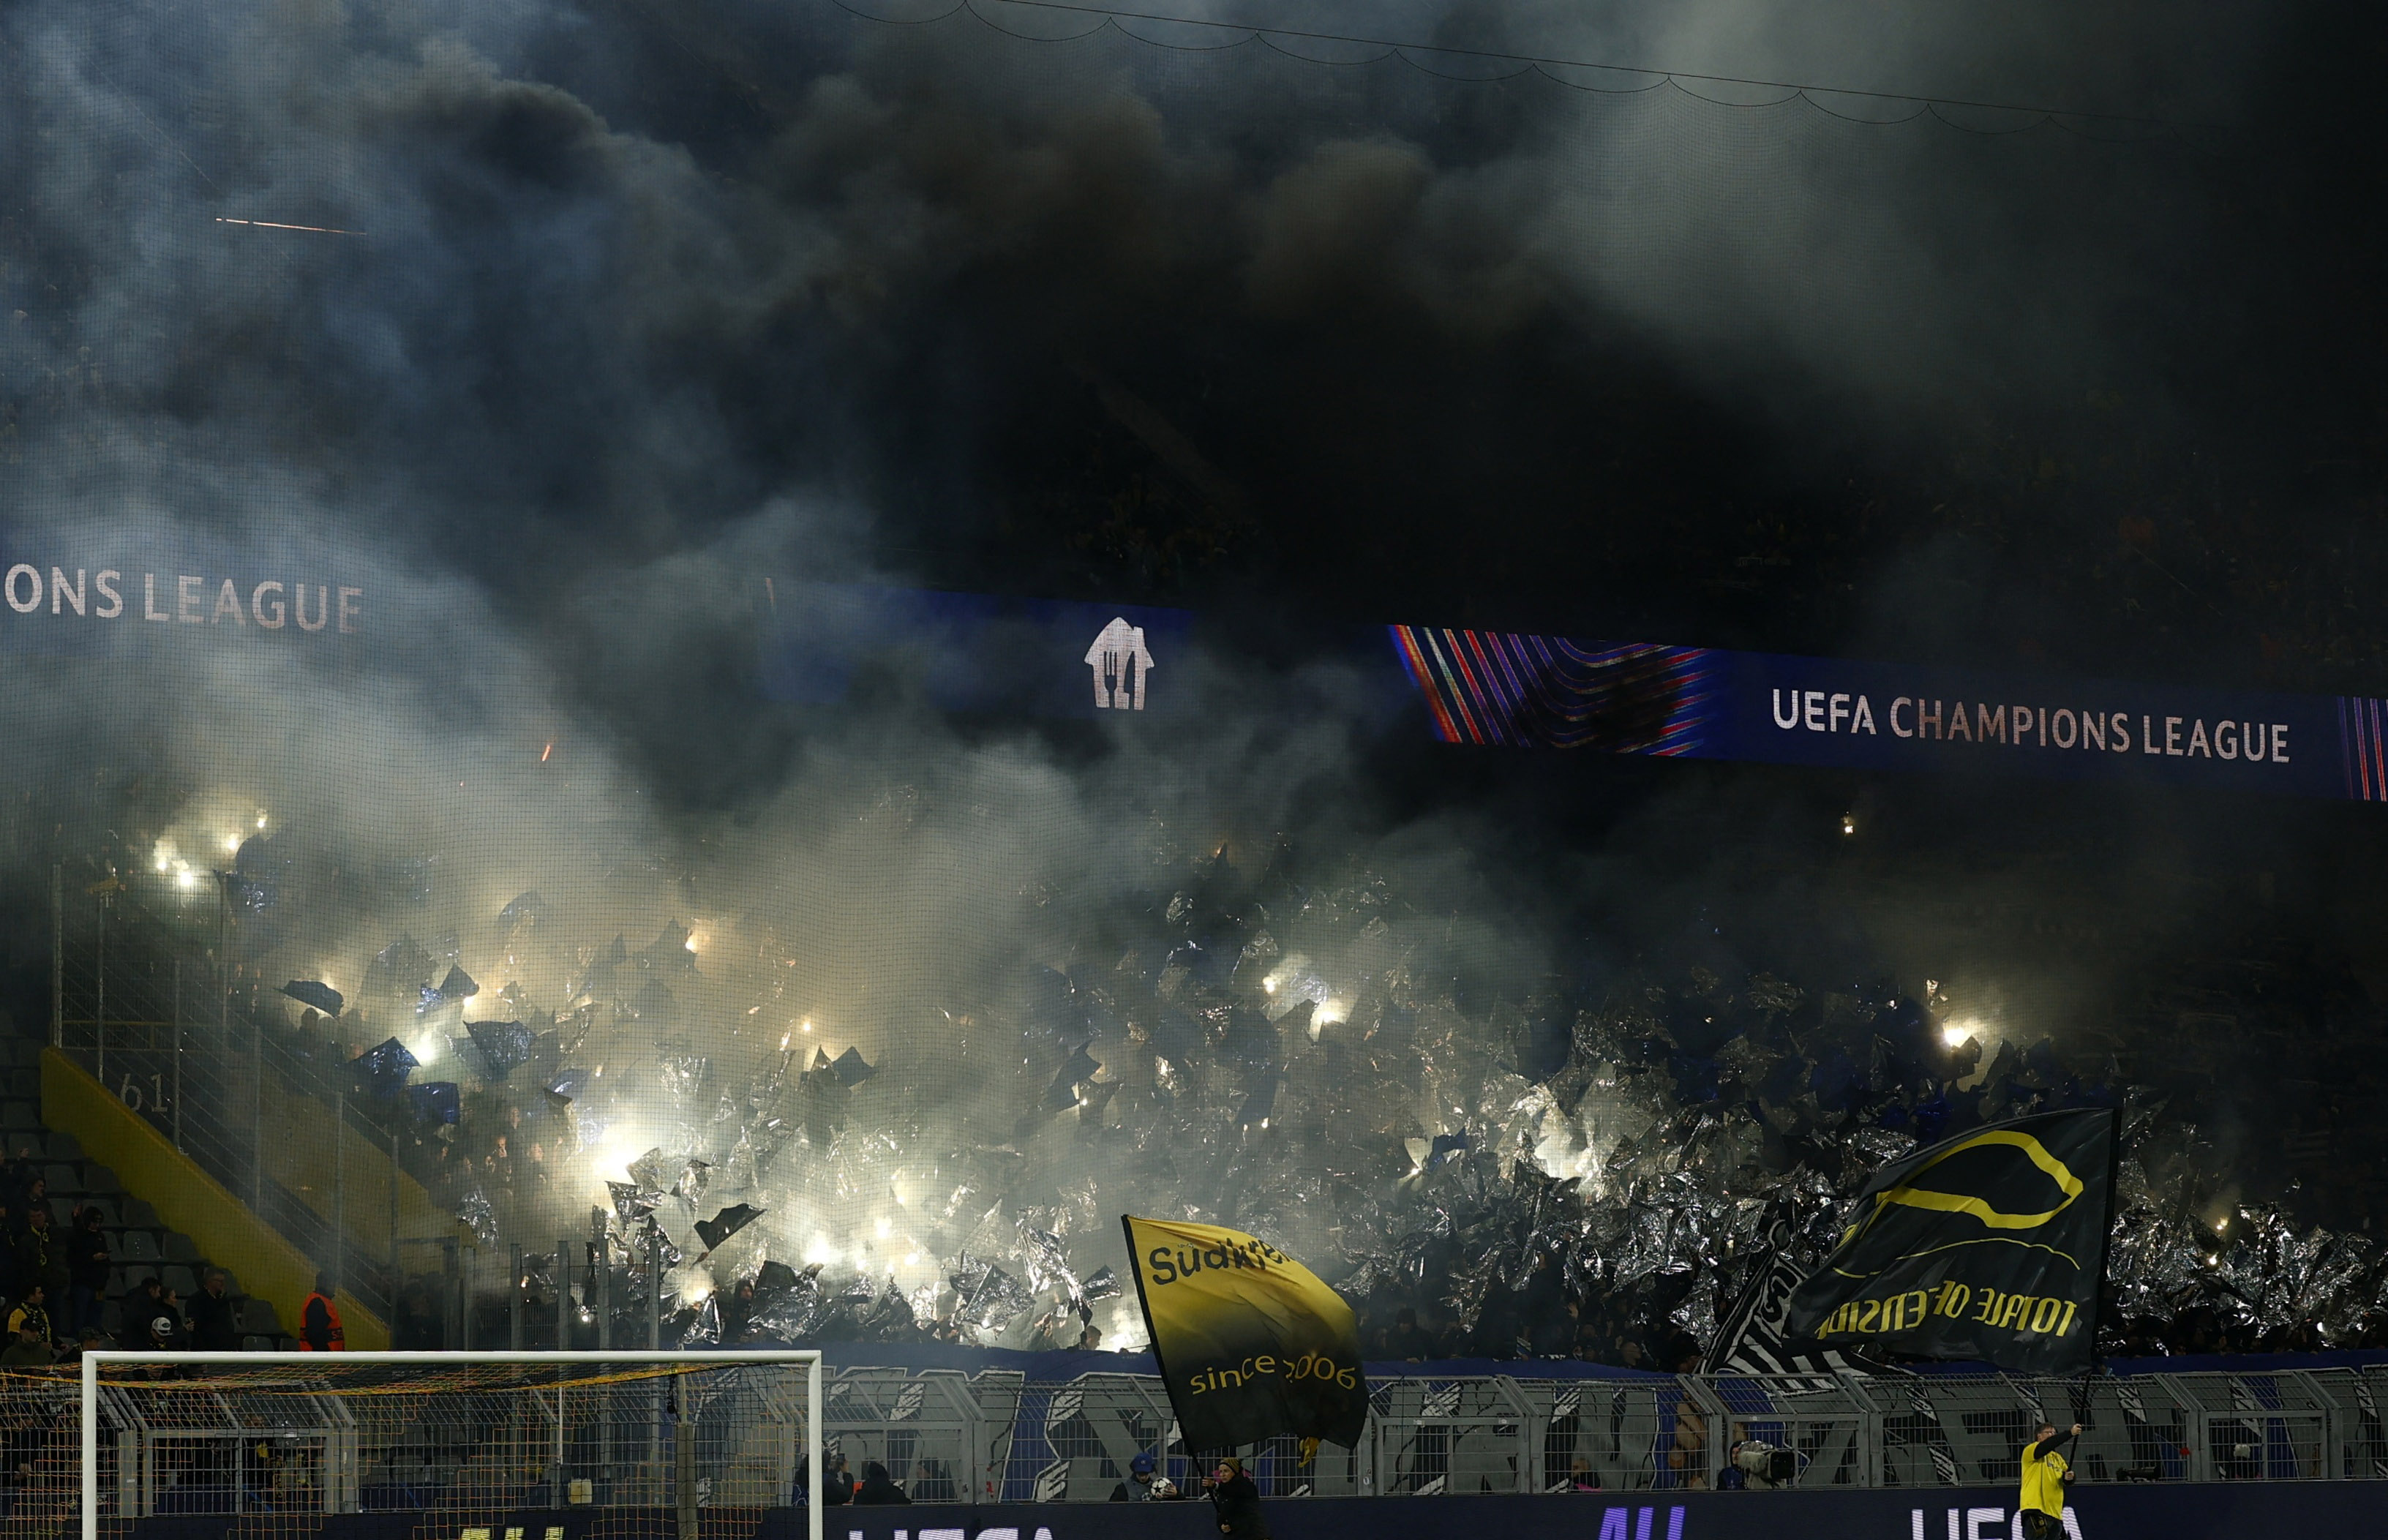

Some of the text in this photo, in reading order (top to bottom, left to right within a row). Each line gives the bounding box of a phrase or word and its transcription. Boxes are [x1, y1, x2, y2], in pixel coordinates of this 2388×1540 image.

[145, 573, 363, 634] LEAGUE
[1772, 688, 2290, 763] UEFA CHAMPIONS LEAGUE
[120, 1073, 168, 1112] 61
[1190, 1355, 1276, 1395] since
